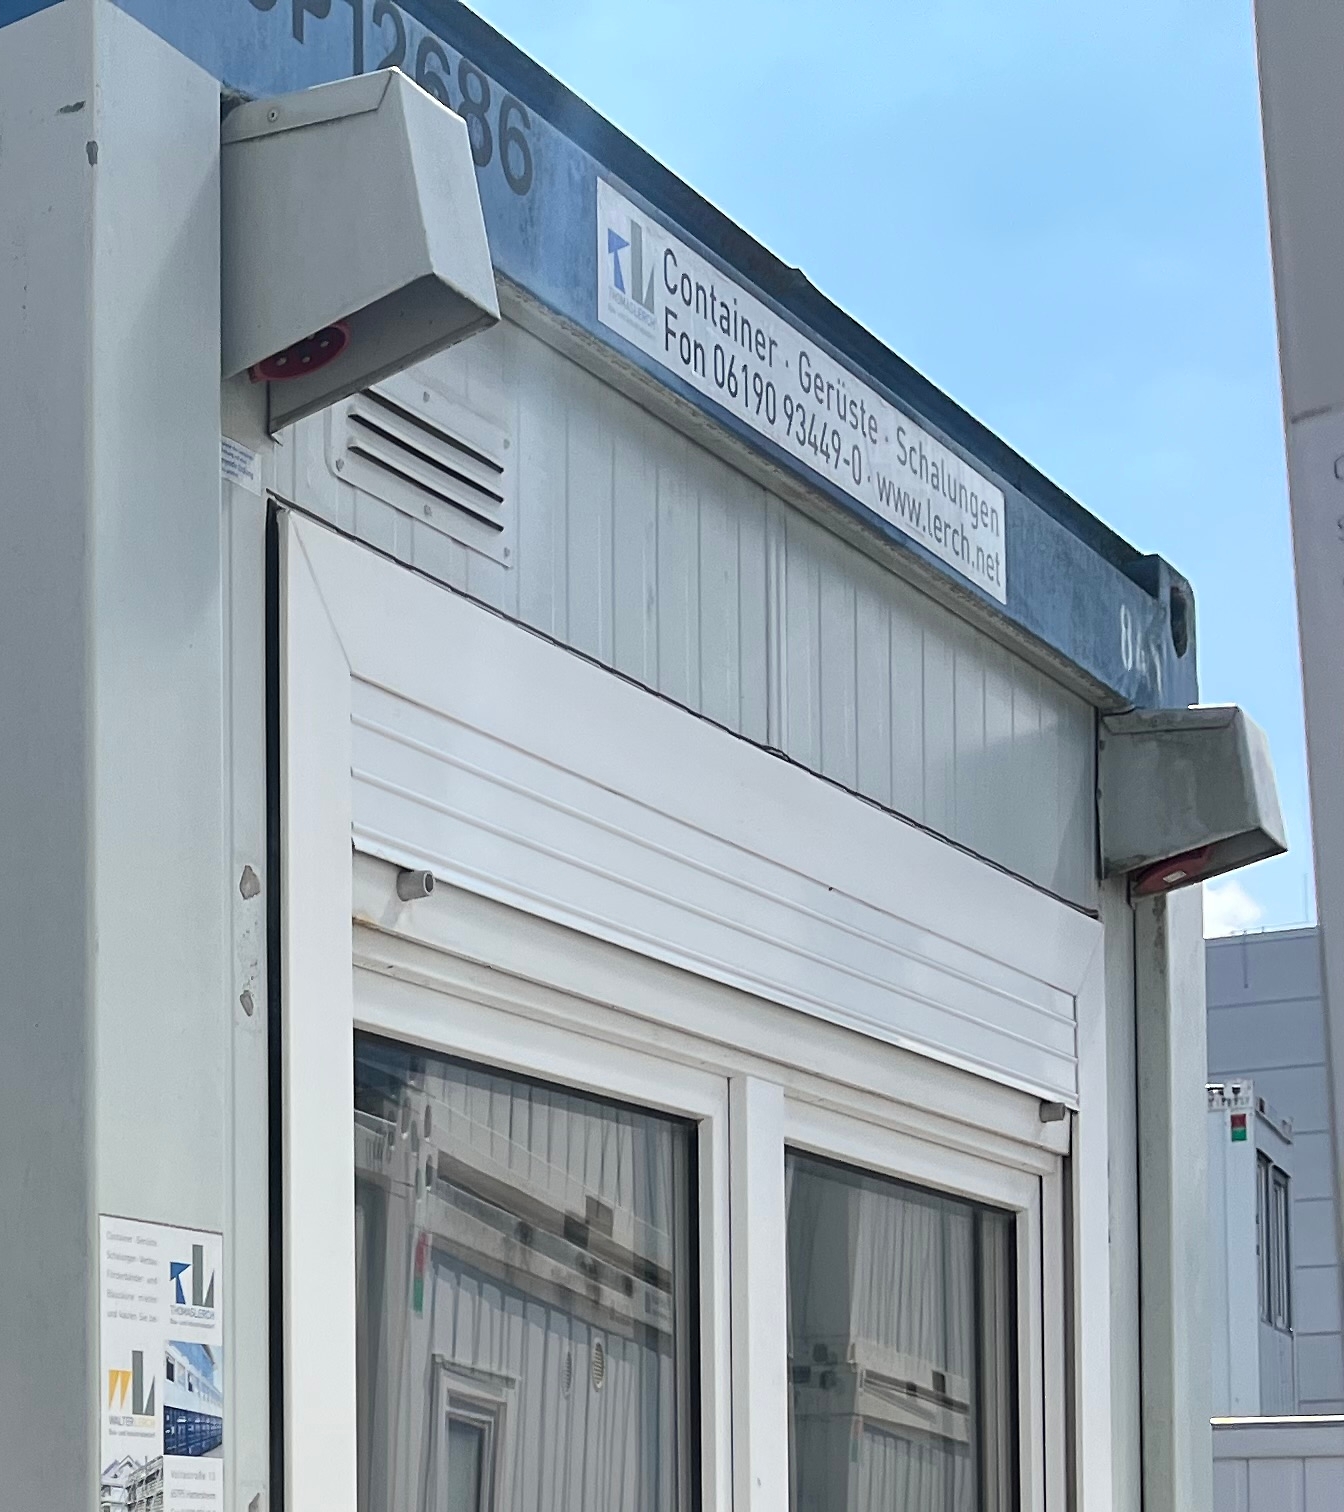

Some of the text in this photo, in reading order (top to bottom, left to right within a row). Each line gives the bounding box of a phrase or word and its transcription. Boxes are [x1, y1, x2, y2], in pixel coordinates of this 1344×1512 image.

[663, 247, 1000, 538] Container Gerüste Schalungen
[665, 305, 706, 378] Fon
[713, 343, 777, 426] 06190
[783, 394, 862, 486] 93449-0
[876, 471, 1001, 588] www.lerch.net
